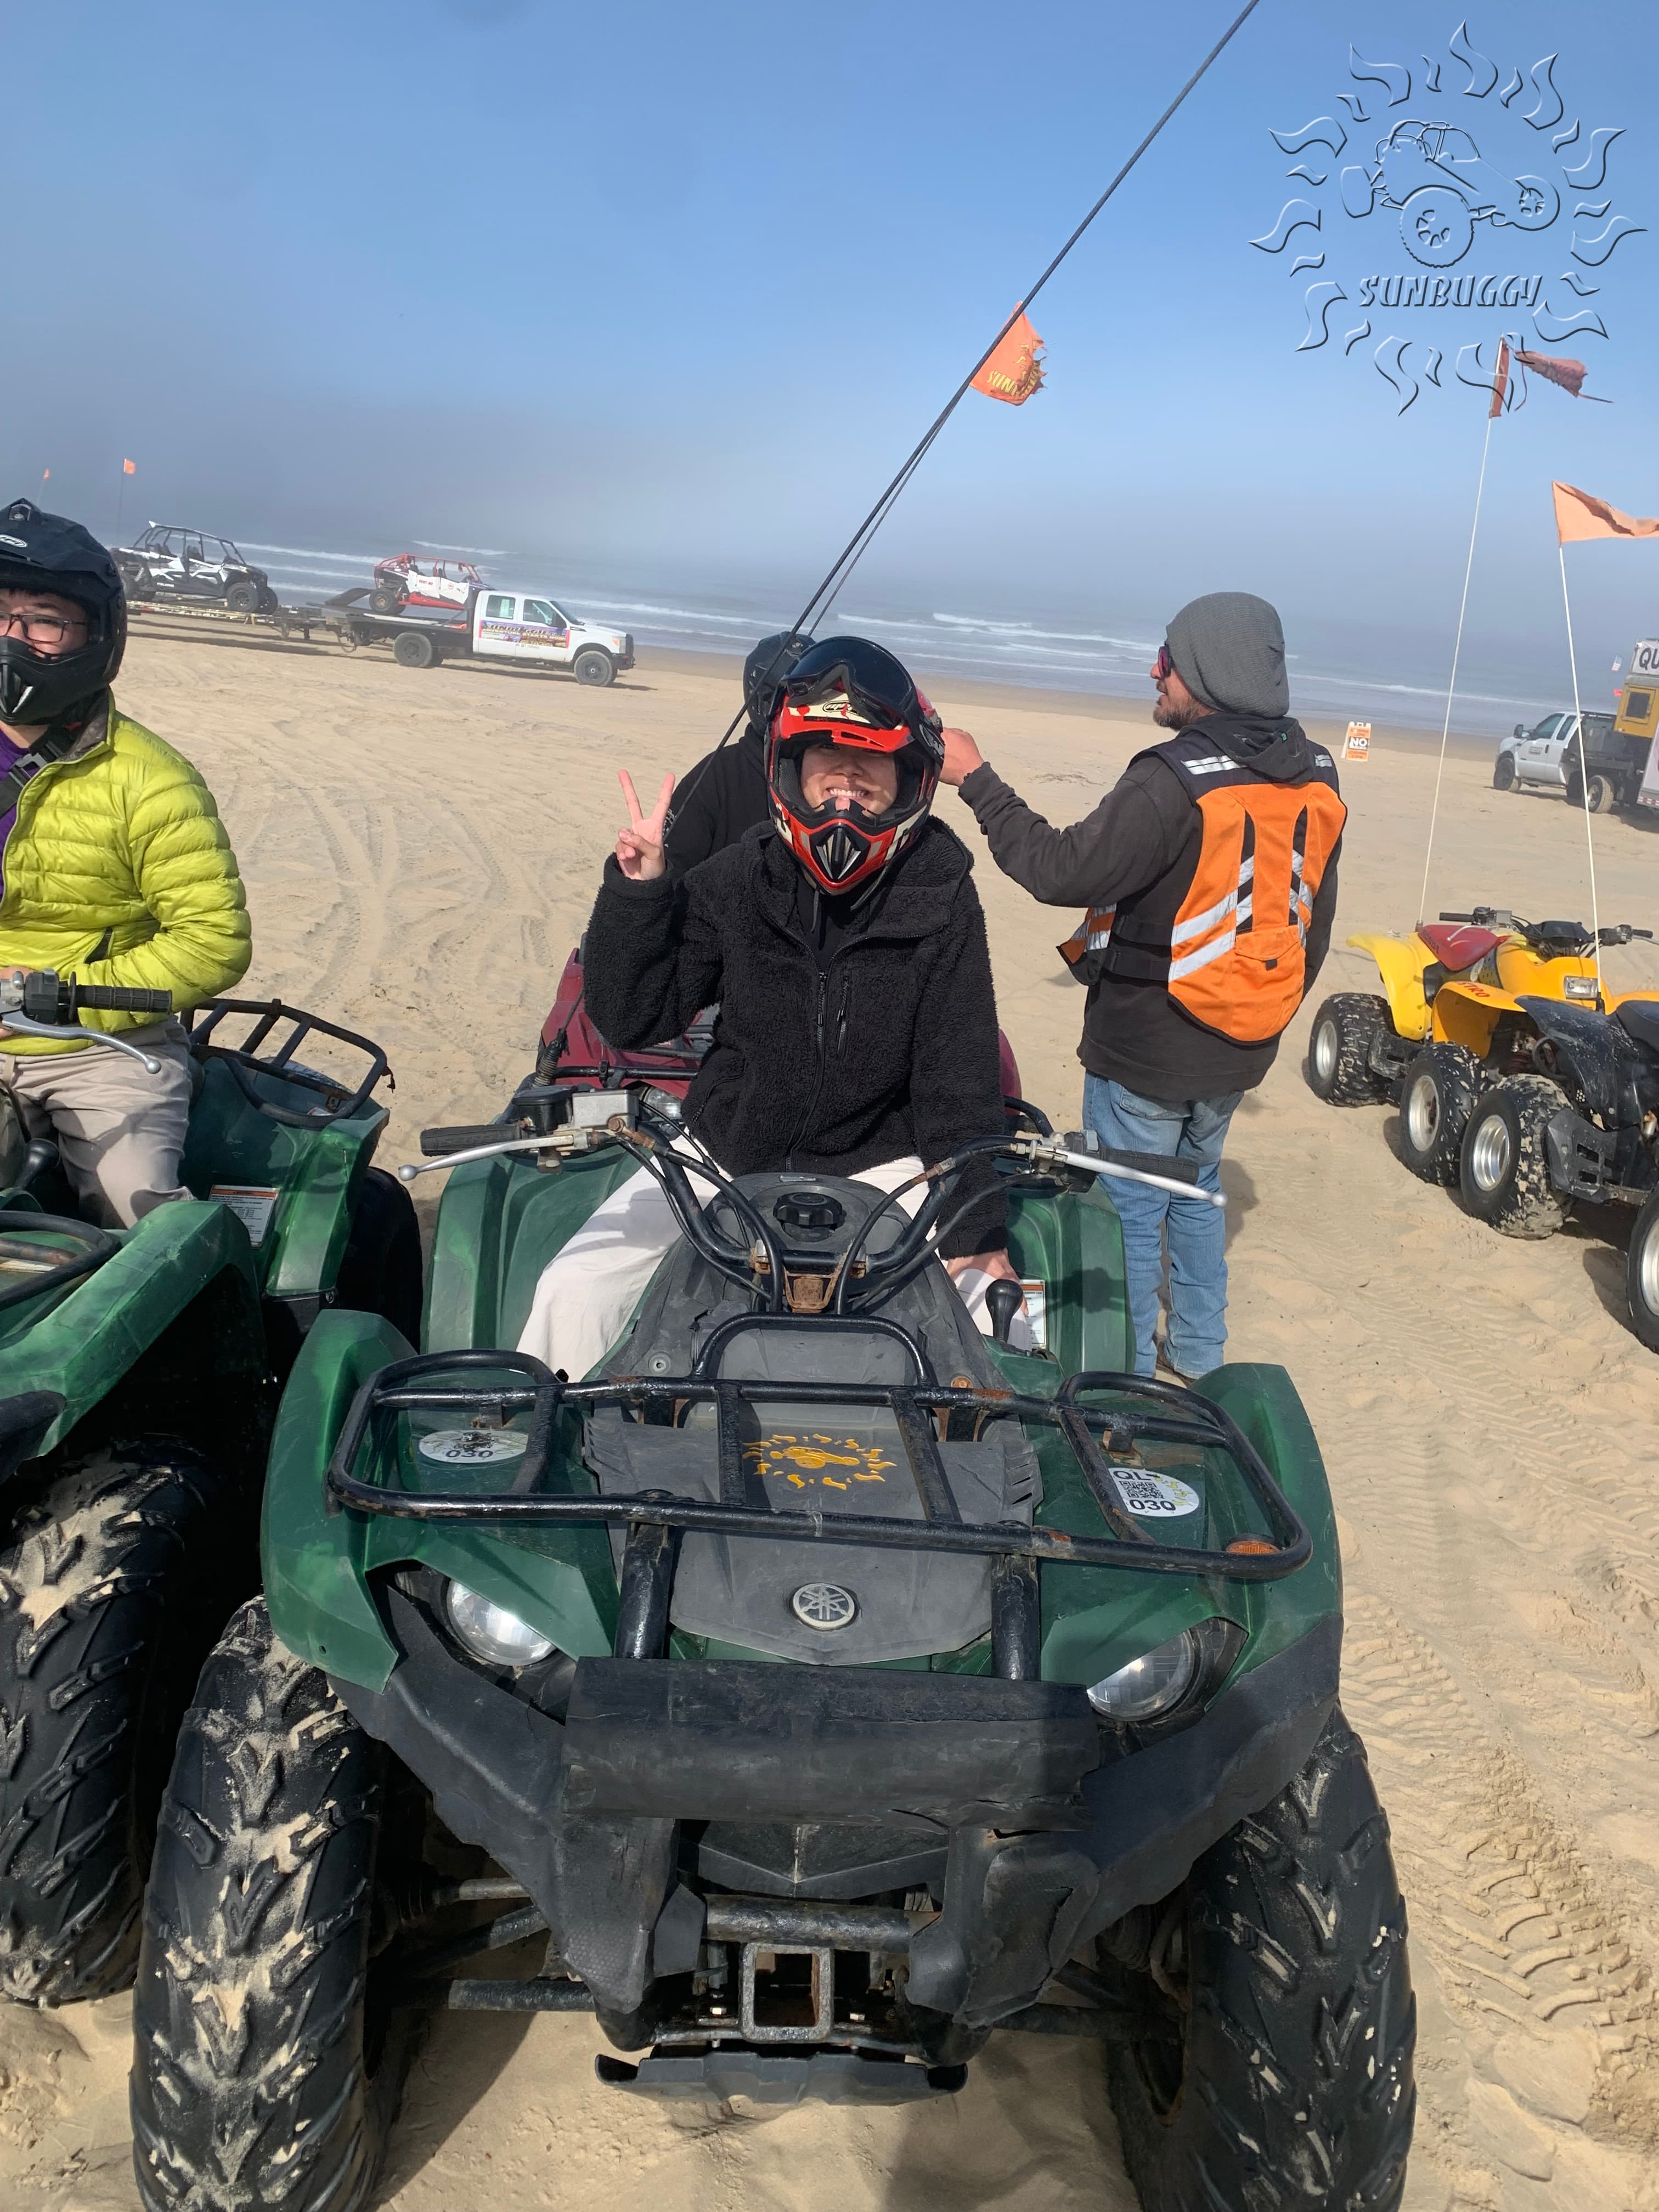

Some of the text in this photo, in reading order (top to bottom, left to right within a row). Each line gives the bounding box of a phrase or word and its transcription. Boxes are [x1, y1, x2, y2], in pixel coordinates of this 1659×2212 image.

[1349, 737, 1368, 747] NO
[445, 1449, 493, 1458] 030
[1129, 1499, 1176, 1511] 030
